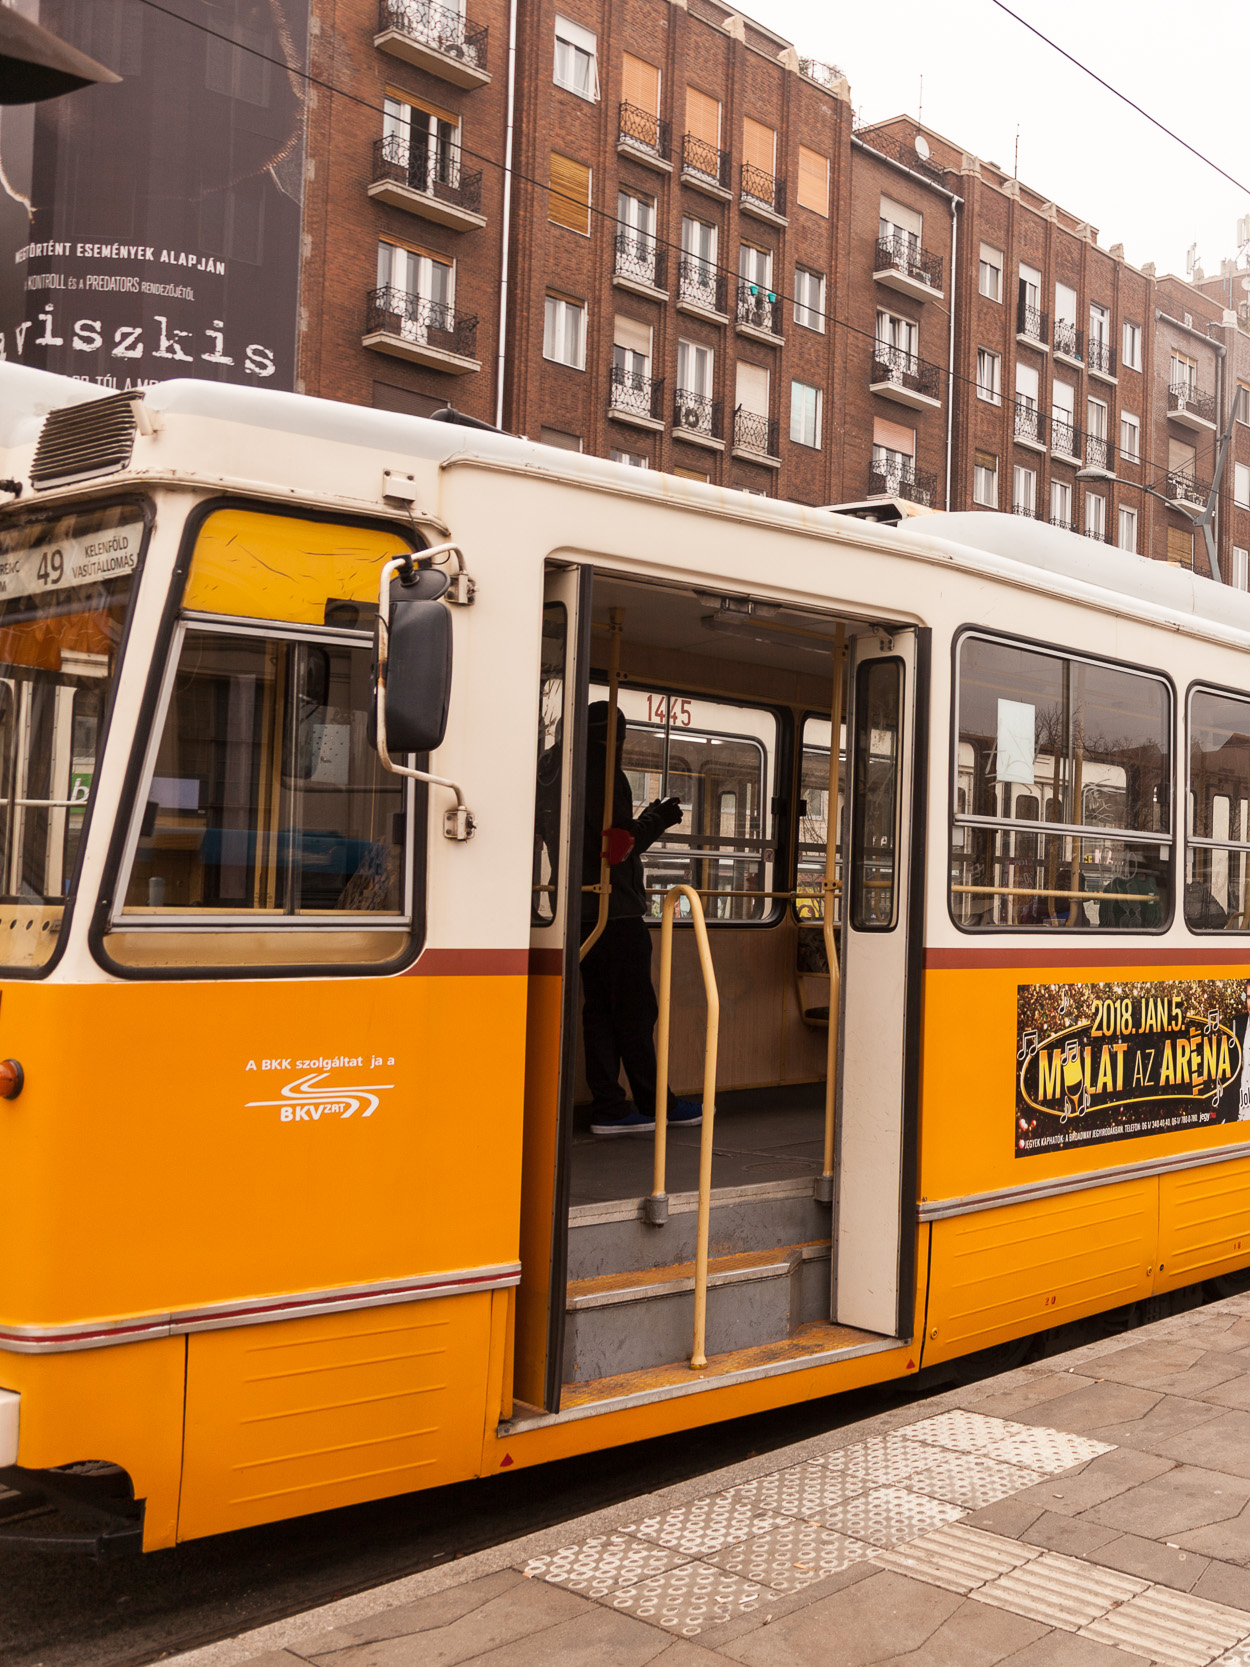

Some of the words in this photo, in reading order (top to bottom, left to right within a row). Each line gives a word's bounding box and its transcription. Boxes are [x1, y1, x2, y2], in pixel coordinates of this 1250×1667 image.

[77, 242, 154, 260] ESEMÉNYEK
[160, 249, 225, 275] ALAPJÁN
[28, 274, 66, 290] KONTROLL
[68, 276, 77, 289] ÉS
[79, 279, 84, 289] A
[86, 275, 140, 292] PREDATORS
[84, 536, 129, 558] KELENFÖLD
[37, 549, 64, 586] 49
[72, 551, 135, 579] VASÚTÁLLOMÁS
[646, 694, 691, 727] 1445
[1090, 998, 1136, 1037] 2018.
[245, 1060, 257, 1071] A
[262, 1058, 292, 1070] BKK
[295, 1056, 363, 1071] szolgáltat
[370, 1055, 383, 1069] ja
[387, 1057, 395, 1066] a
[1132, 1049, 1155, 1088] AZ
